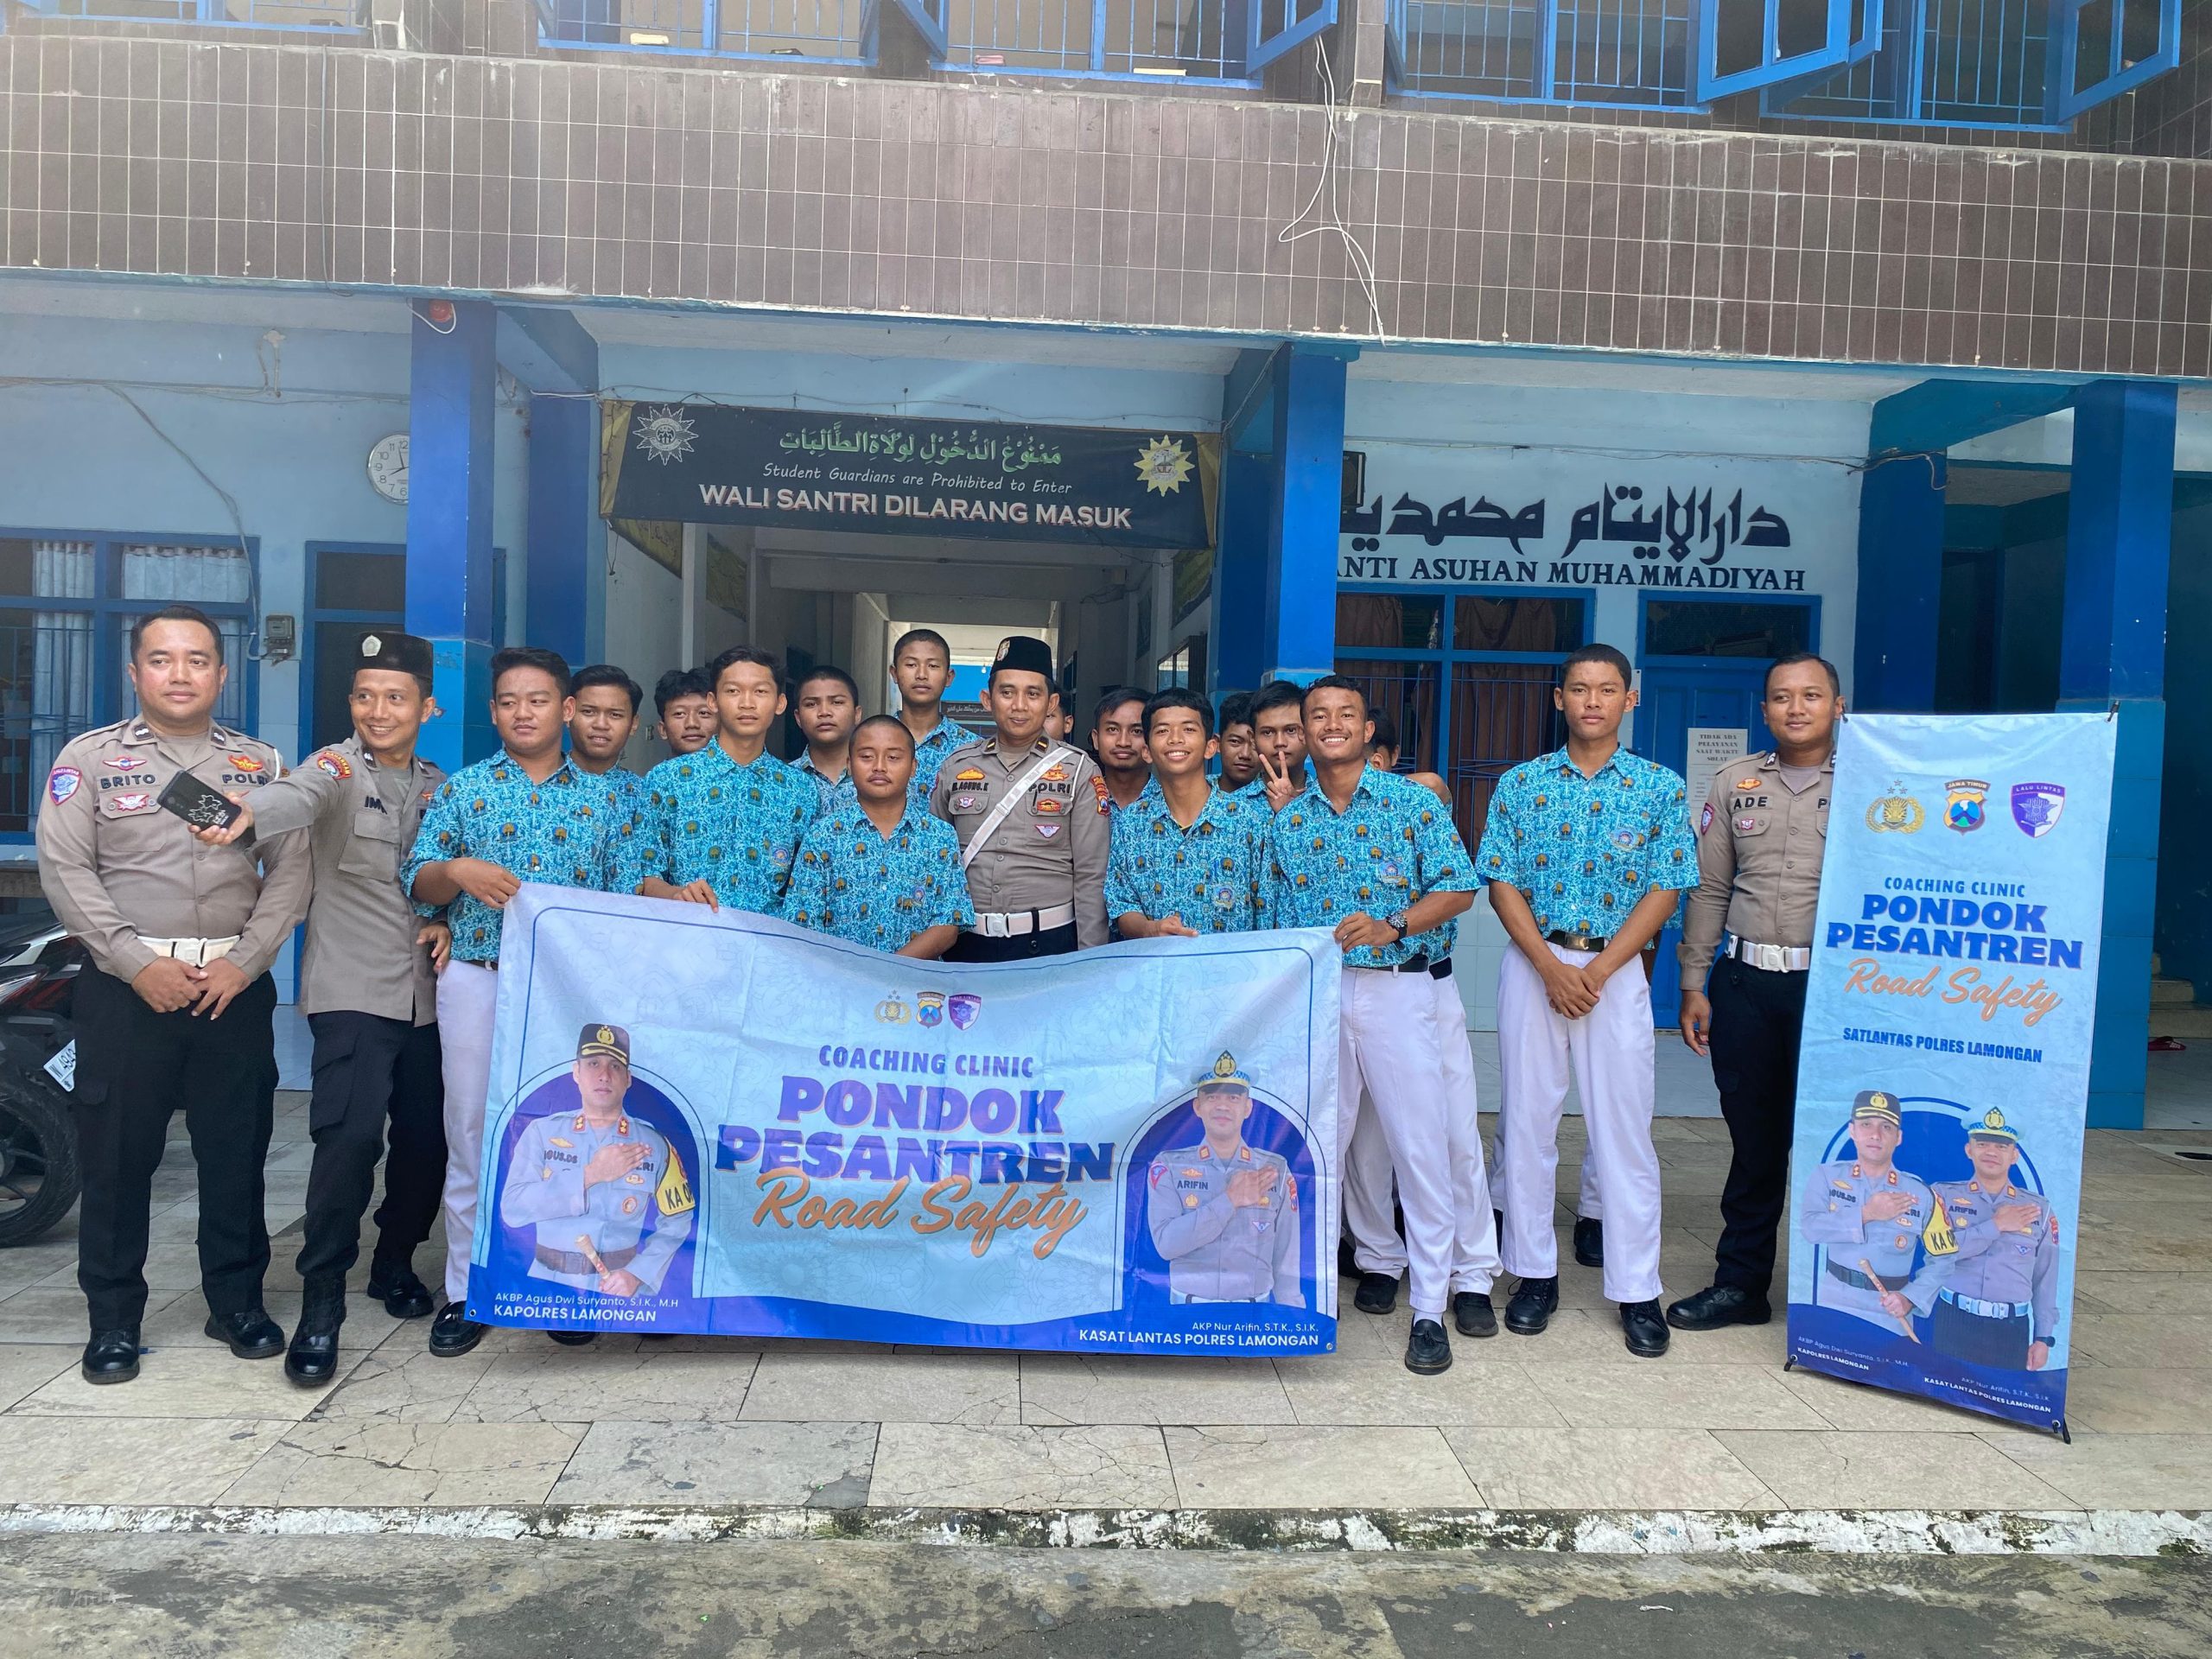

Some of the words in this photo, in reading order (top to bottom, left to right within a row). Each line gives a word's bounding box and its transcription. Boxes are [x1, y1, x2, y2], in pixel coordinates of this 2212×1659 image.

[389, 442, 395, 451] 11
[378, 451, 389, 461] 10
[375, 462, 383, 472] 9
[379, 474, 387, 483] 8
[763, 462, 821, 480] Student
[830, 467, 895, 484] Guardians
[902, 475, 924, 486] are
[931, 472, 1002, 490] Prohibited
[1010, 480, 1025, 492] to
[1033, 479, 1071, 495] Enter
[389, 483, 395, 493] 7
[400, 486, 408, 496] 6
[699, 484, 771, 509] WALI
[777, 489, 878, 515] SANTRI
[885, 495, 1028, 523] DILARANG
[1036, 505, 1133, 530] MASUK
[1409, 558, 1538, 582] ASUHAN
[1548, 563, 1806, 591] MUHAMMADIYAH
[101, 773, 156, 790] BRITO
[1028, 782, 1071, 794] POLRI
[1947, 780, 1966, 789] JAWA
[1967, 780, 1987, 789] TIMUR
[2036, 785, 2062, 793] LINTAS
[1733, 796, 1768, 810] ADE
[1884, 877, 1966, 894] COACHING
[1971, 881, 2026, 898] CLINIC
[1860, 893, 2049, 934] PONDOK
[1825, 921, 2084, 970] PESANTREN
[1843, 957, 1942, 997] Road
[1941, 965, 2063, 1027] Safety
[1843, 1027, 1913, 1048] SATLANTAS
[1916, 1035, 1965, 1055] POLRES
[1967, 1040, 2044, 1064] LAMONGAN
[818, 1044, 946, 1075] COACHING
[955, 1053, 1033, 1078] CLINIC
[776, 1074, 1065, 1136] PONDOK
[715, 1123, 1116, 1185] PESANTREN
[1176, 1180, 1209, 1191] ARIFIN
[752, 1166, 911, 1230] Road
[911, 1174, 1089, 1261] Safety
[1948, 1205, 1978, 1216] ARIFIN
[495, 1293, 524, 1303] AKBP
[525, 1294, 552, 1306] Agus
[556, 1294, 575, 1304] Dwi
[576, 1295, 628, 1308] Suryanto,
[630, 1297, 657, 1308] S.I.K.,
[493, 1304, 568, 1320] KAPOLRES
[570, 1307, 657, 1323] LAMONGAN
[1192, 1321, 1212, 1331] AKP
[1214, 1322, 1232, 1332] Nur
[1234, 1321, 1262, 1332] Arifin,
[1264, 1322, 1294, 1332] S.T.K.,
[1295, 1323, 1319, 1332] S.I.K.
[1079, 1329, 1125, 1343] KASAT
[1128, 1331, 1181, 1345] LANTAS
[1185, 1333, 1236, 1346] POLRES
[1238, 1334, 1319, 1346] LAMONGAN
[1815, 1340, 1830, 1350] Agus
[1797, 1346, 1830, 1360] KAPOLRES
[1830, 1355, 1869, 1370] LAMONGAN
[1924, 1376, 1948, 1388] KASAT
[1949, 1382, 1978, 1395] LANTAS
[1978, 1390, 2005, 1404] POLRES
[2005, 1399, 2051, 1414] LAMONGAN
